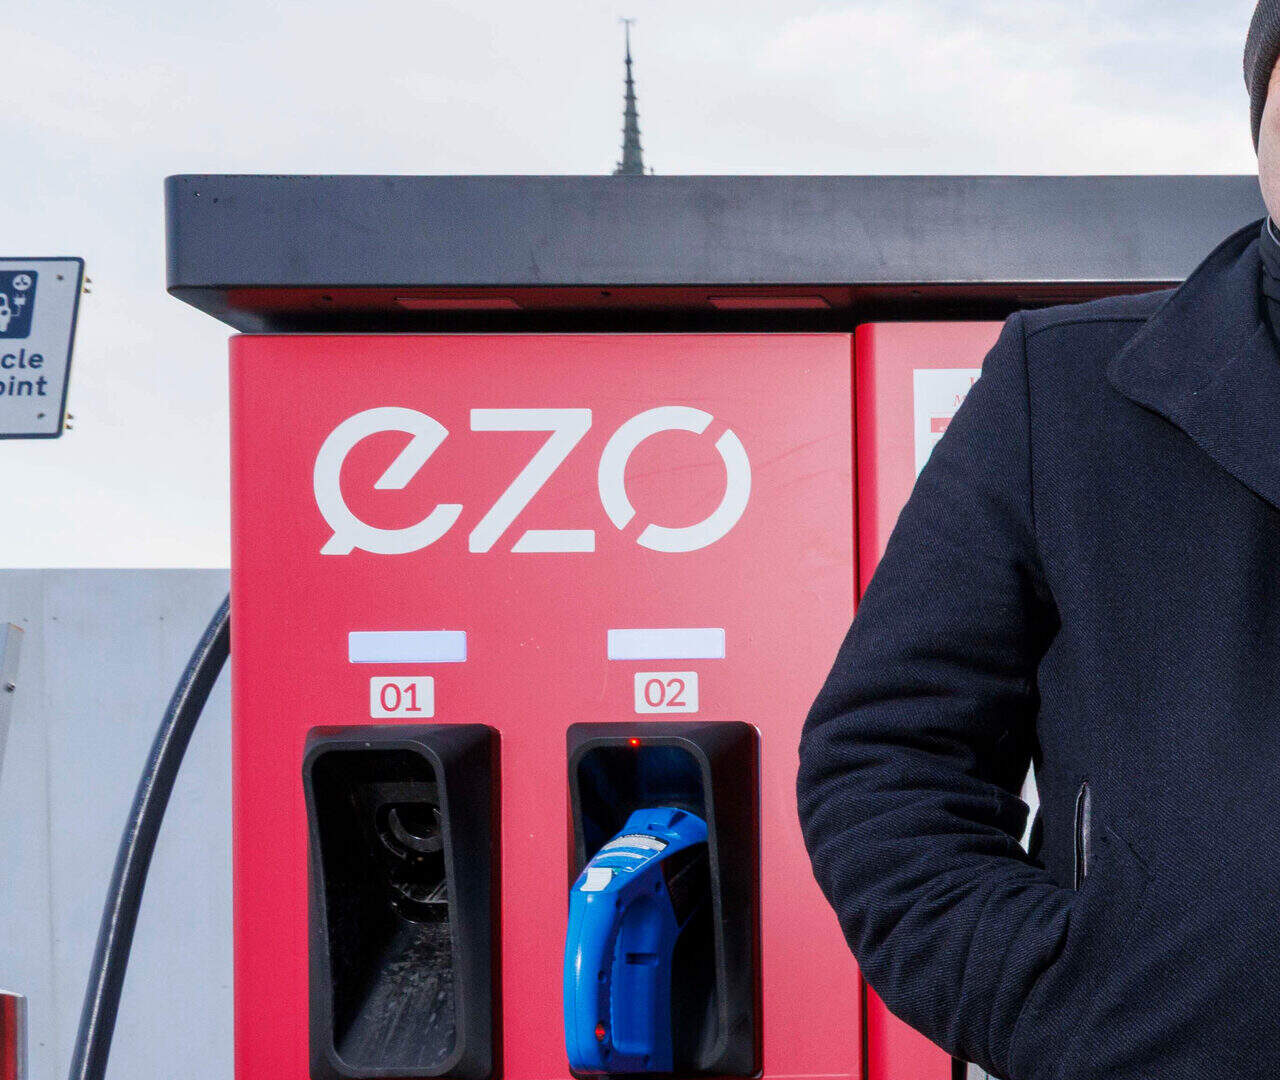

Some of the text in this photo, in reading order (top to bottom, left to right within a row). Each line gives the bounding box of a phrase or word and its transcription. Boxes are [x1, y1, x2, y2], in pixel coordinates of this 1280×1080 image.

[0, 348, 44, 369] cle
[314, 406, 752, 555] ezo
[380, 683, 422, 712] 01
[645, 679, 686, 707] 02
